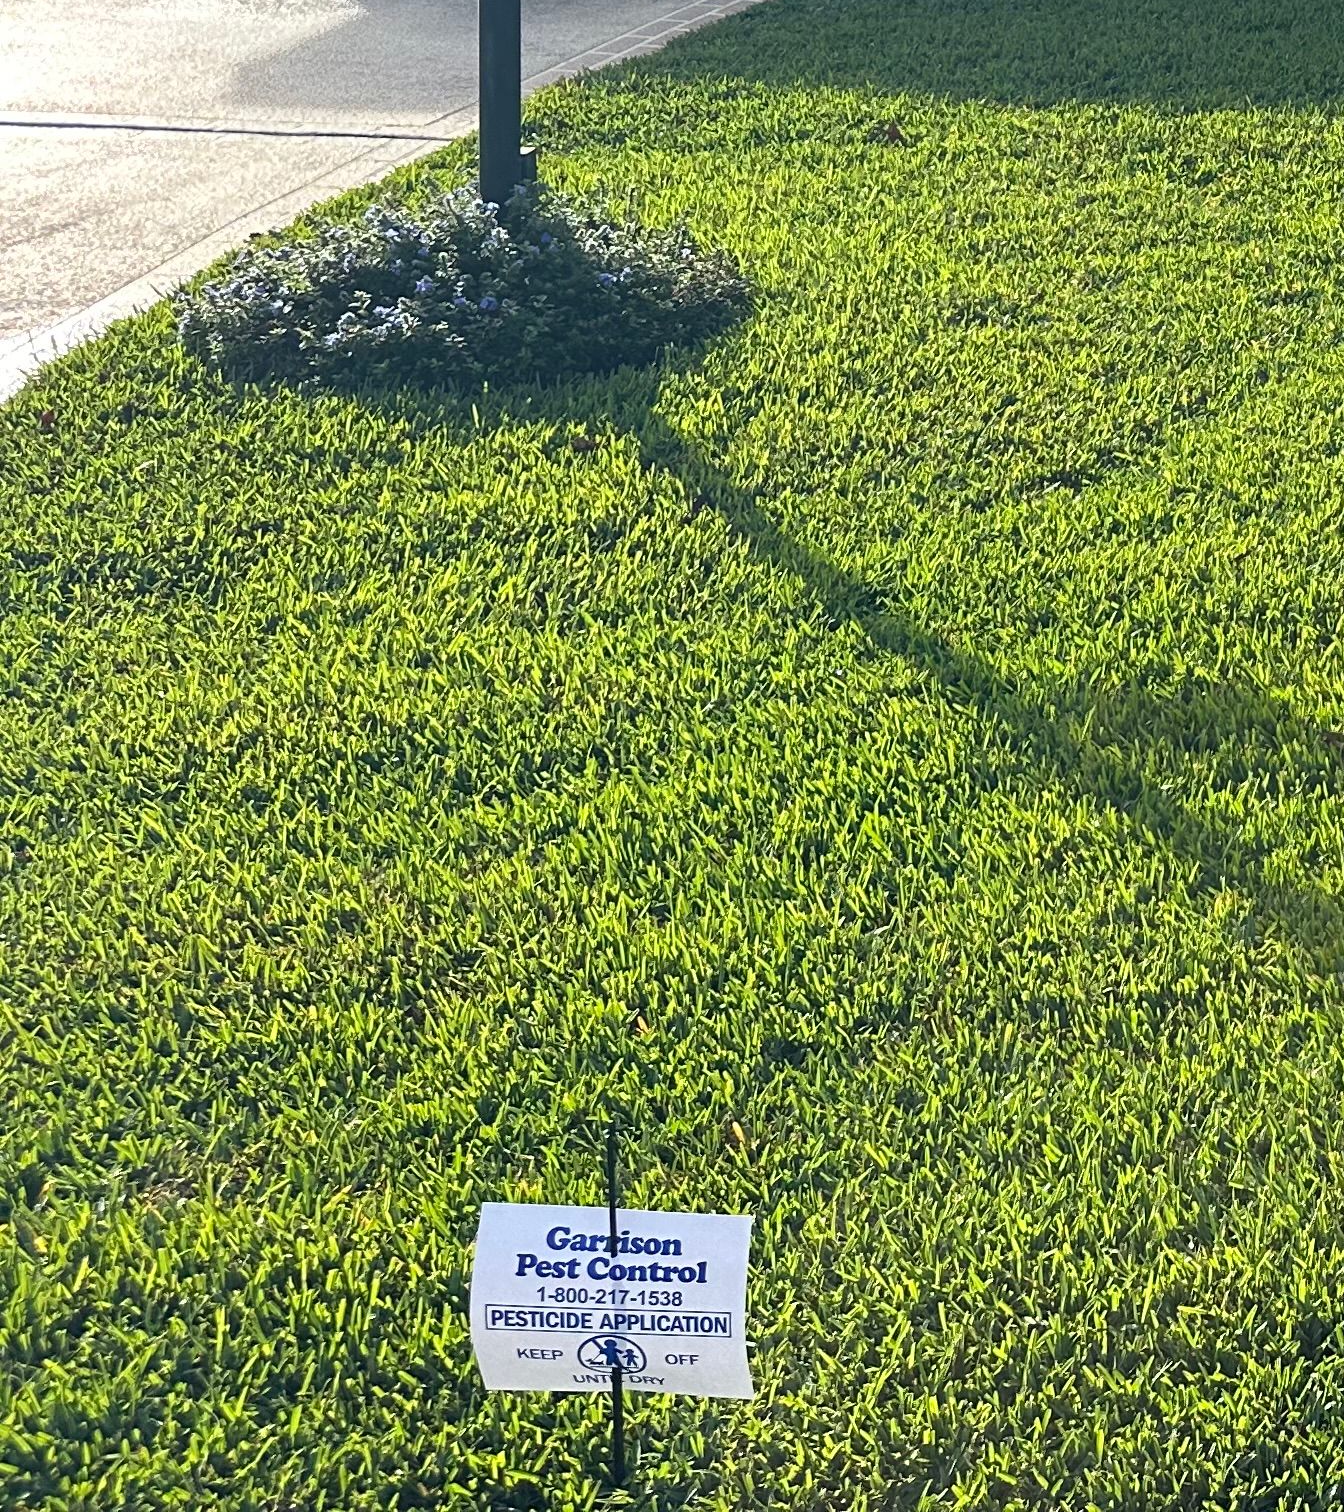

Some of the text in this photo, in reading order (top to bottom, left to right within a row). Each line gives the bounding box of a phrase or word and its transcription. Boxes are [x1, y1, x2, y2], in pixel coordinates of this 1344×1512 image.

[546, 1226, 683, 1256] Garrison
[515, 1253, 707, 1283] Pest Control
[536, 1287, 683, 1307] 1-800-217-1538
[491, 1309, 728, 1334] PESTICIDE APPLICATION
[516, 1348, 700, 1366] KEEP OFF
[573, 1374, 665, 1385] UNT DRY
